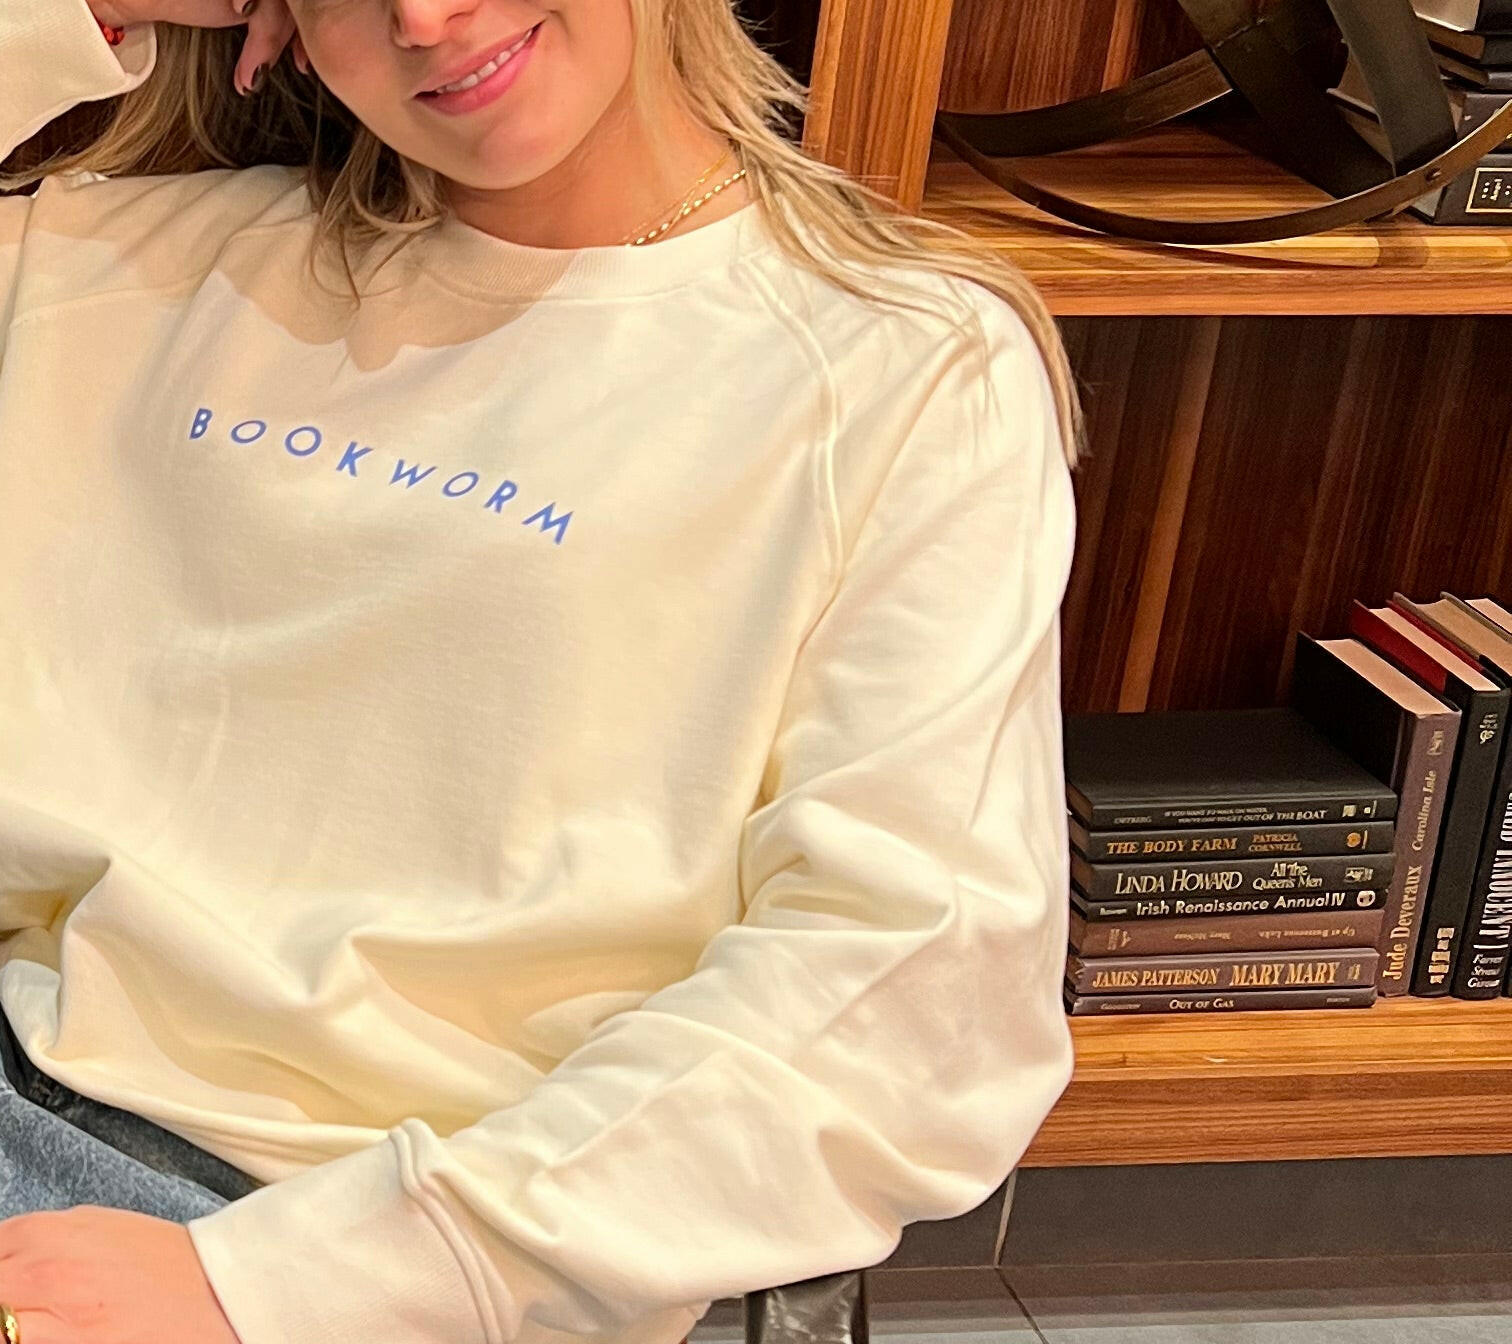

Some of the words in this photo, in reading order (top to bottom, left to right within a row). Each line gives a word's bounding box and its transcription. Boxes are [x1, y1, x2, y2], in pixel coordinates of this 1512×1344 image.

[188, 408, 574, 545] BOOKWORM
[1107, 843, 1138, 855] THE
[1142, 841, 1186, 853] BODY
[1191, 838, 1237, 851] FARM
[1115, 873, 1165, 895] LINDA
[1171, 870, 1243, 893] HOWARD
[1137, 903, 1169, 916] Irish
[1176, 899, 1269, 914] Renaissance
[1274, 894, 1329, 909] Annual
[1330, 893, 1344, 907] IV
[1391, 865, 1421, 942] Deveraux
[1383, 943, 1407, 981] Jude
[1093, 971, 1138, 988] JAMES
[1141, 968, 1220, 987] PATTERSON
[1229, 965, 1284, 986] MARY
[1285, 963, 1340, 984] MARY
